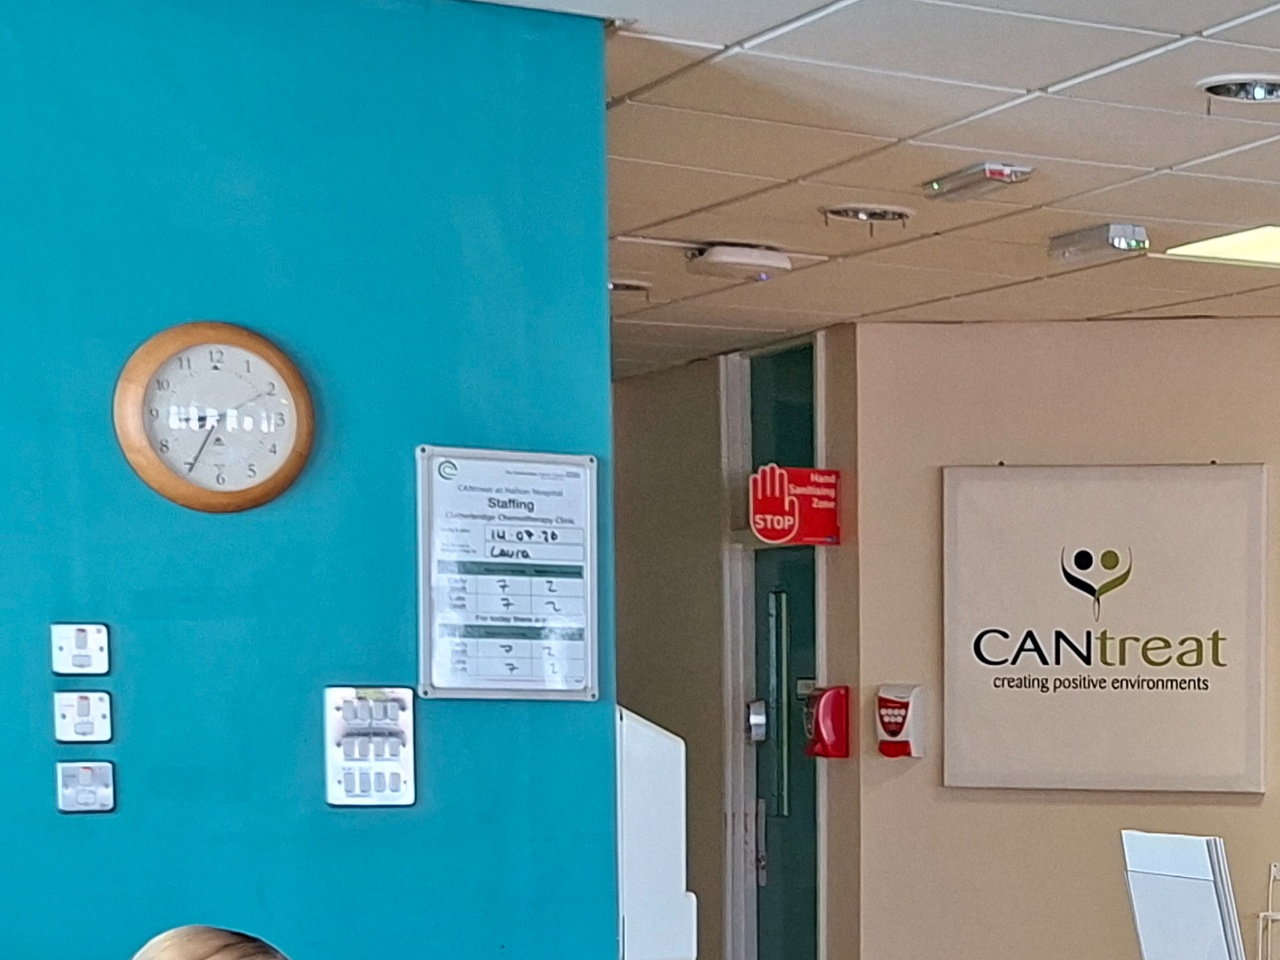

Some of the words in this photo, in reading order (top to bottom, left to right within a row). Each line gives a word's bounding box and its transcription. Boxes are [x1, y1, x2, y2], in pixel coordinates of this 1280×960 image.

[177, 357, 192, 371] 11
[208, 350, 225, 364] 12
[245, 359, 252, 374] 1
[156, 378, 171, 392] 10
[266, 381, 276, 397] 2
[150, 408, 159, 419] 9
[276, 412, 286, 427] 3
[159, 439, 170, 454] 8
[268, 443, 278, 456] 4
[247, 463, 257, 478] 5
[215, 473, 226, 486] 6
[810, 472, 836, 484] Hand
[487, 497, 535, 513] Staffing
[811, 497, 836, 509] Zone
[754, 514, 794, 530] STOP
[490, 546, 531, 559] Laura
[497, 579, 509, 594] 7
[545, 580, 558, 593] 2
[501, 597, 515, 610] 7
[973, 628, 1228, 668] CANtreat
[993, 673, 1050, 693] creating
[1053, 674, 1107, 693] positive
[1111, 674, 1210, 691] environments
